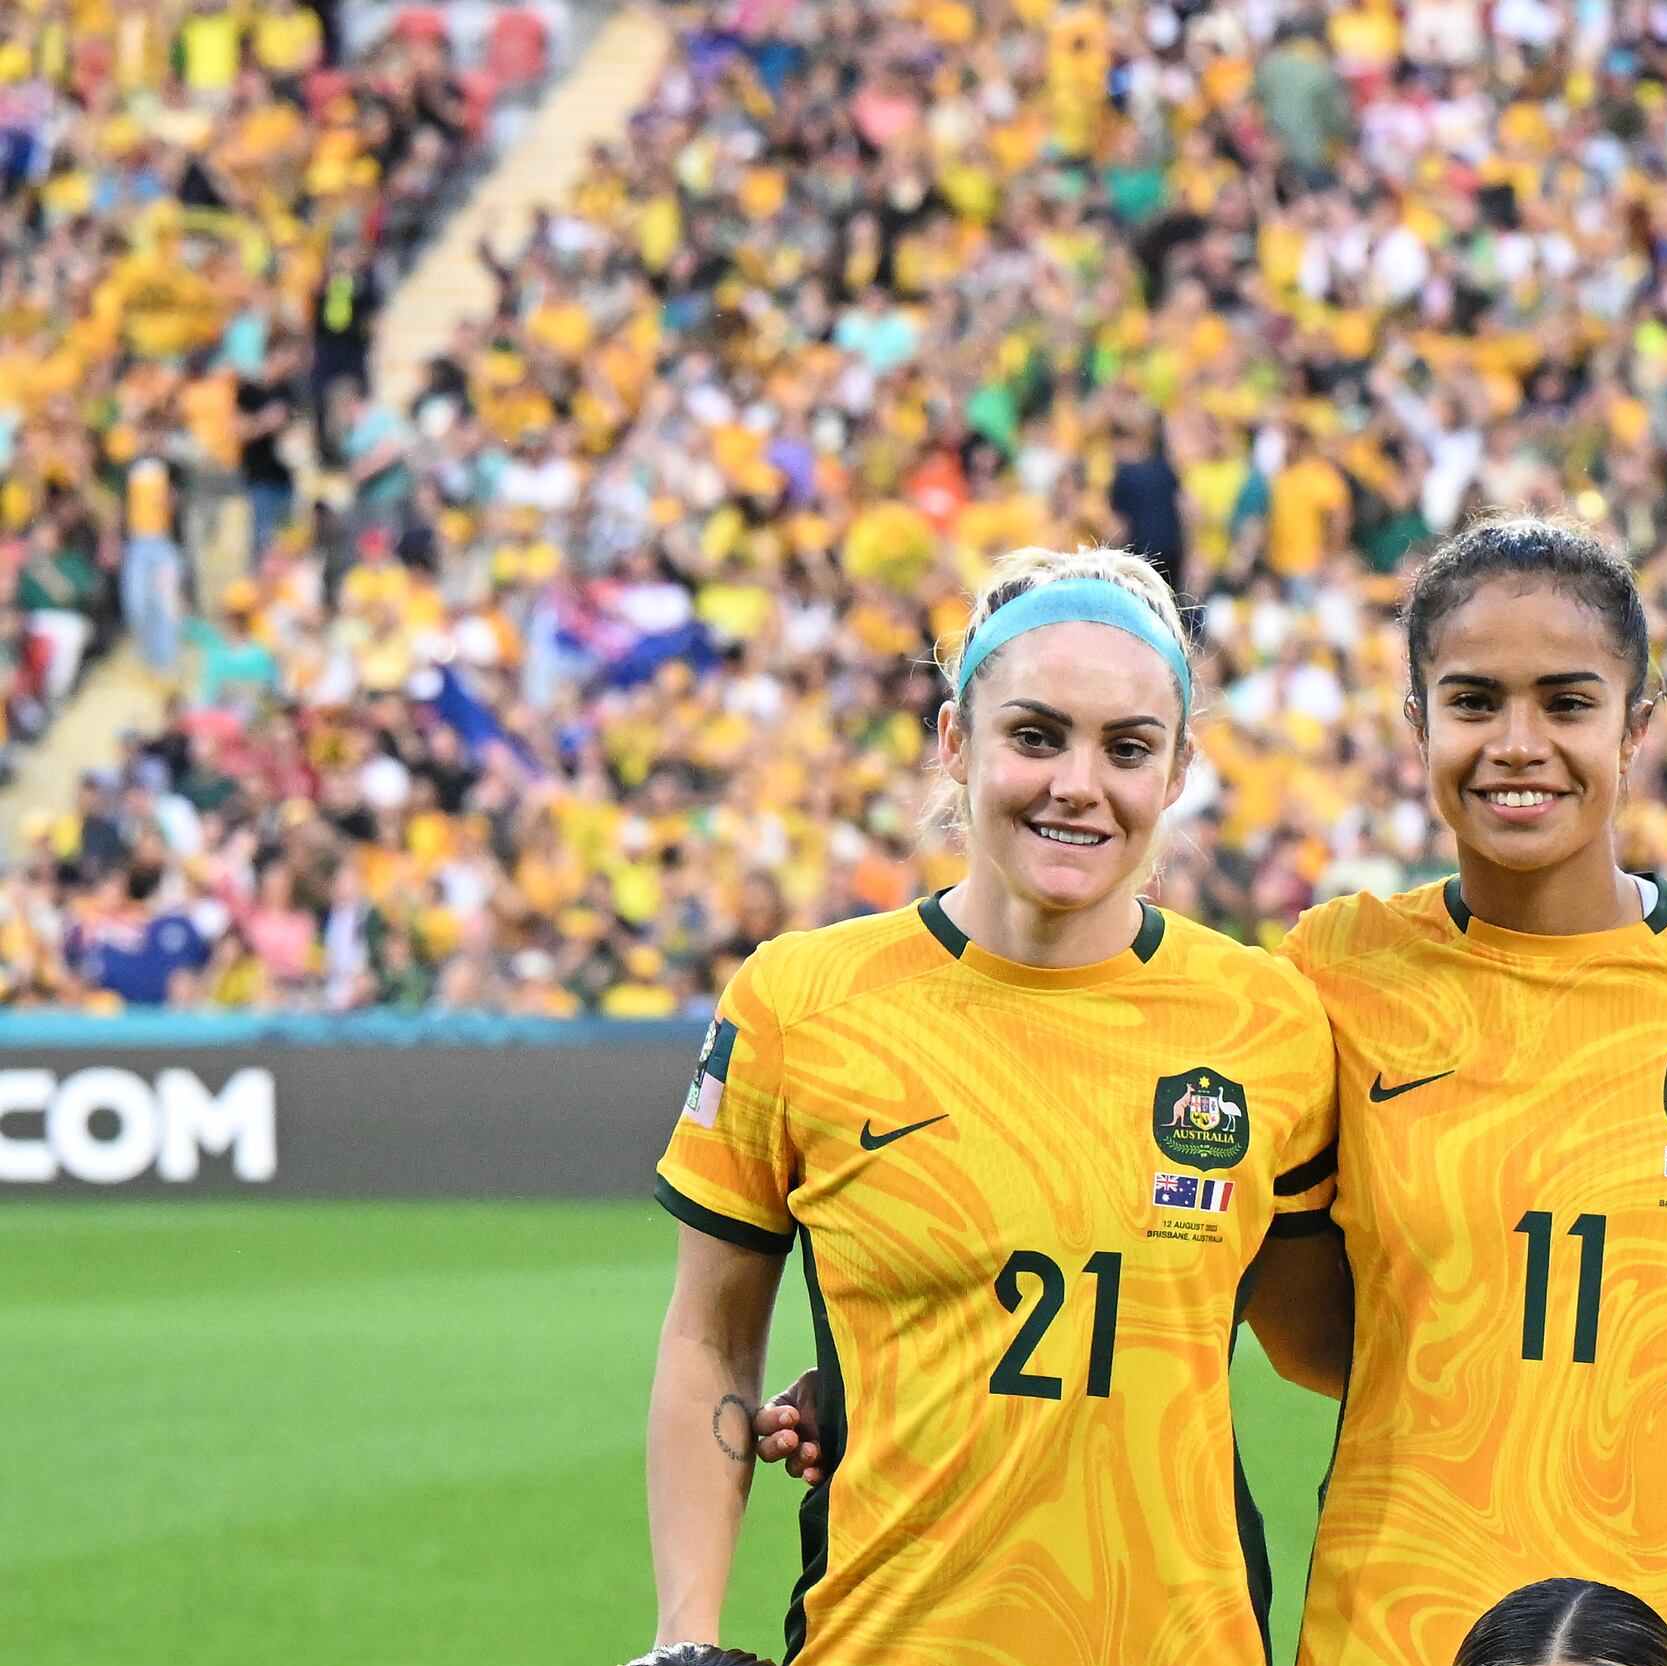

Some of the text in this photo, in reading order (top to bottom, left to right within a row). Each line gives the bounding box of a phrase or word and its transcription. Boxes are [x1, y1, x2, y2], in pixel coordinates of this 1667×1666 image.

[0, 1066, 277, 1184] COM
[1173, 1129, 1235, 1144] AUSTRALIA
[1147, 1230, 1190, 1241] BRISBANE,
[1163, 1220, 1172, 1228] 12
[1174, 1221, 1204, 1230] AUGUST
[1512, 1210, 1607, 1364] 11
[989, 1250, 1123, 1400] 21
